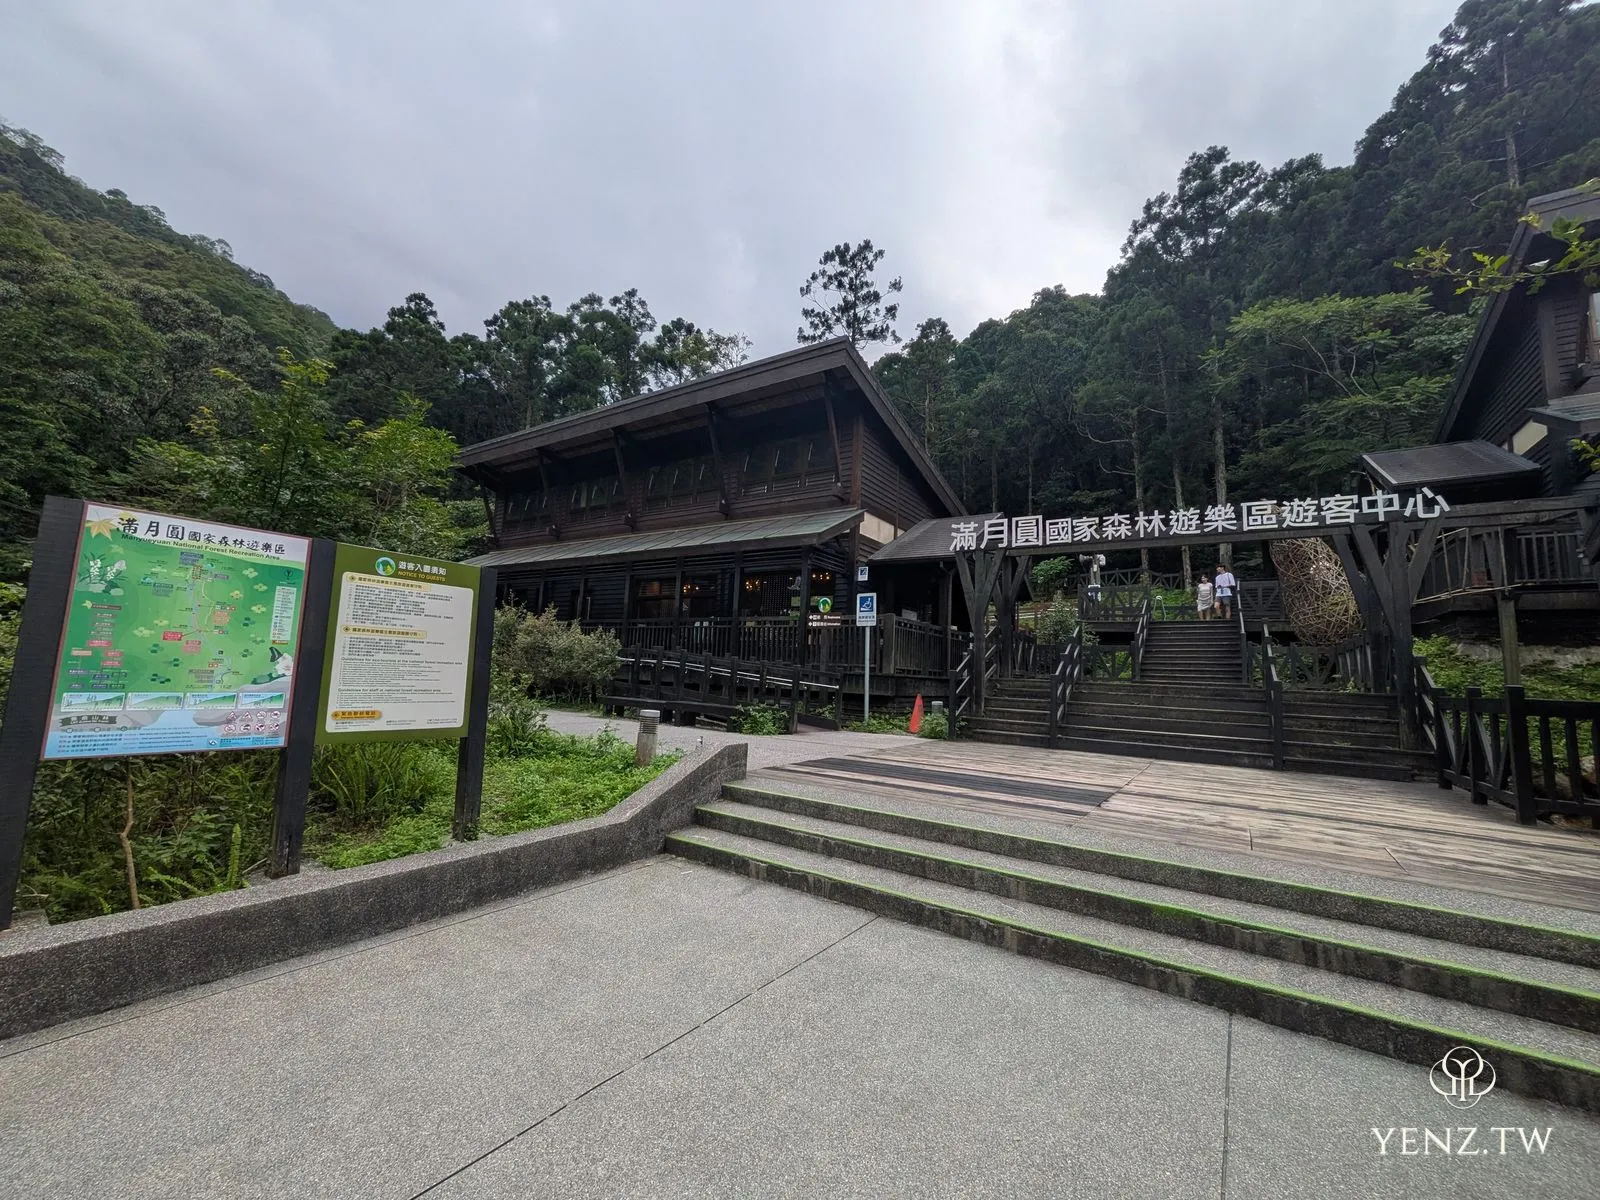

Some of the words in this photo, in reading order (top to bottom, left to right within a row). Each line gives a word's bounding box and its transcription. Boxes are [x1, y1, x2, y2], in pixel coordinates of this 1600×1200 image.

[948, 486, 1450, 552] 滿月圓國家森林遊樂區遊客中心
[121, 533, 171, 546] Manyueyuan
[173, 541, 203, 551] National
[205, 546, 228, 554] Forest
[229, 549, 264, 558] Recreation
[426, 574, 446, 582] GUESTS
